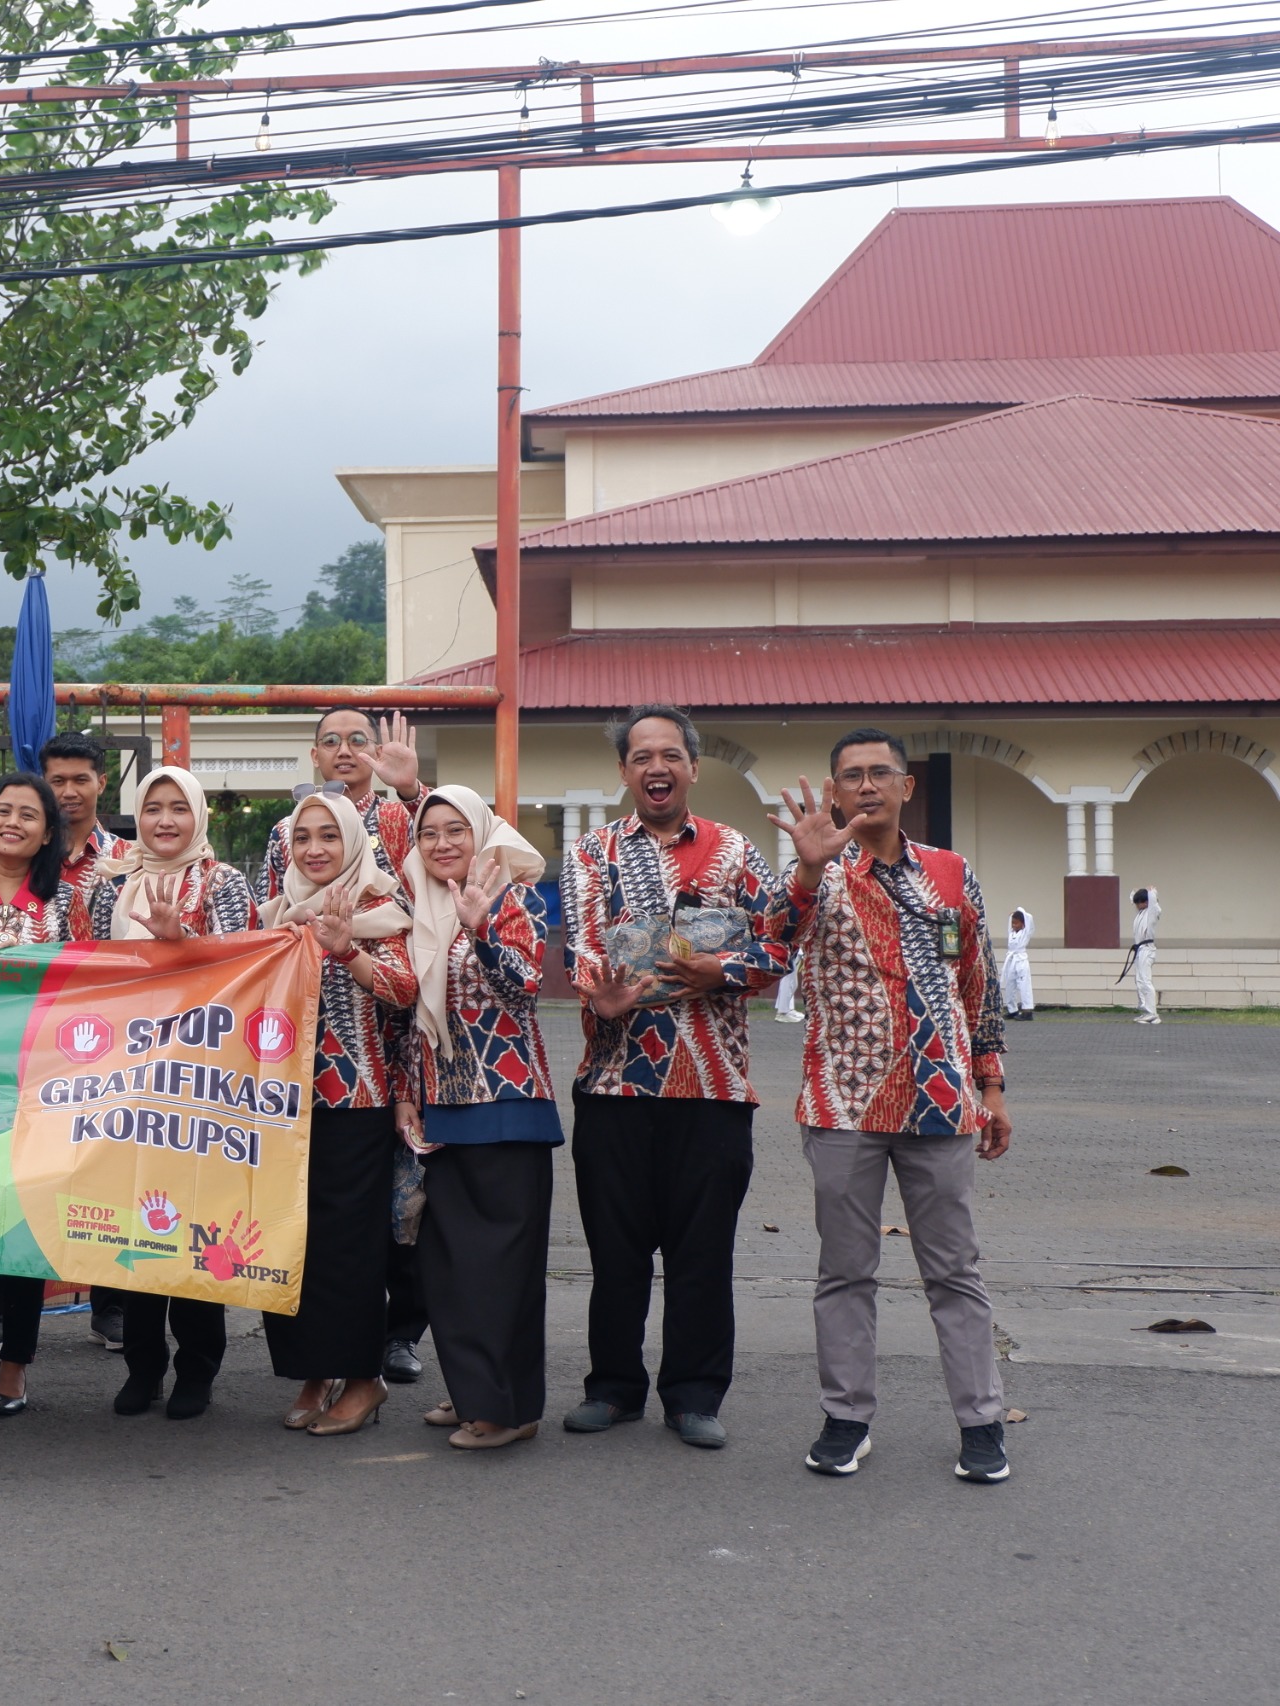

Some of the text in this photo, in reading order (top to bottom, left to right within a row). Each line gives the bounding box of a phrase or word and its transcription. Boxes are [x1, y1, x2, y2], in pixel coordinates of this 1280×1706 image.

[126, 1003, 235, 1056] STOP
[39, 1059, 301, 1121] GRATIFIKASI
[70, 1106, 261, 1168] KORUPSI
[66, 1203, 116, 1222] STOP
[66, 1219, 120, 1234] GRATIFIKASI
[67, 1230, 178, 1253] LIHAT LAWAN LAPORKAN
